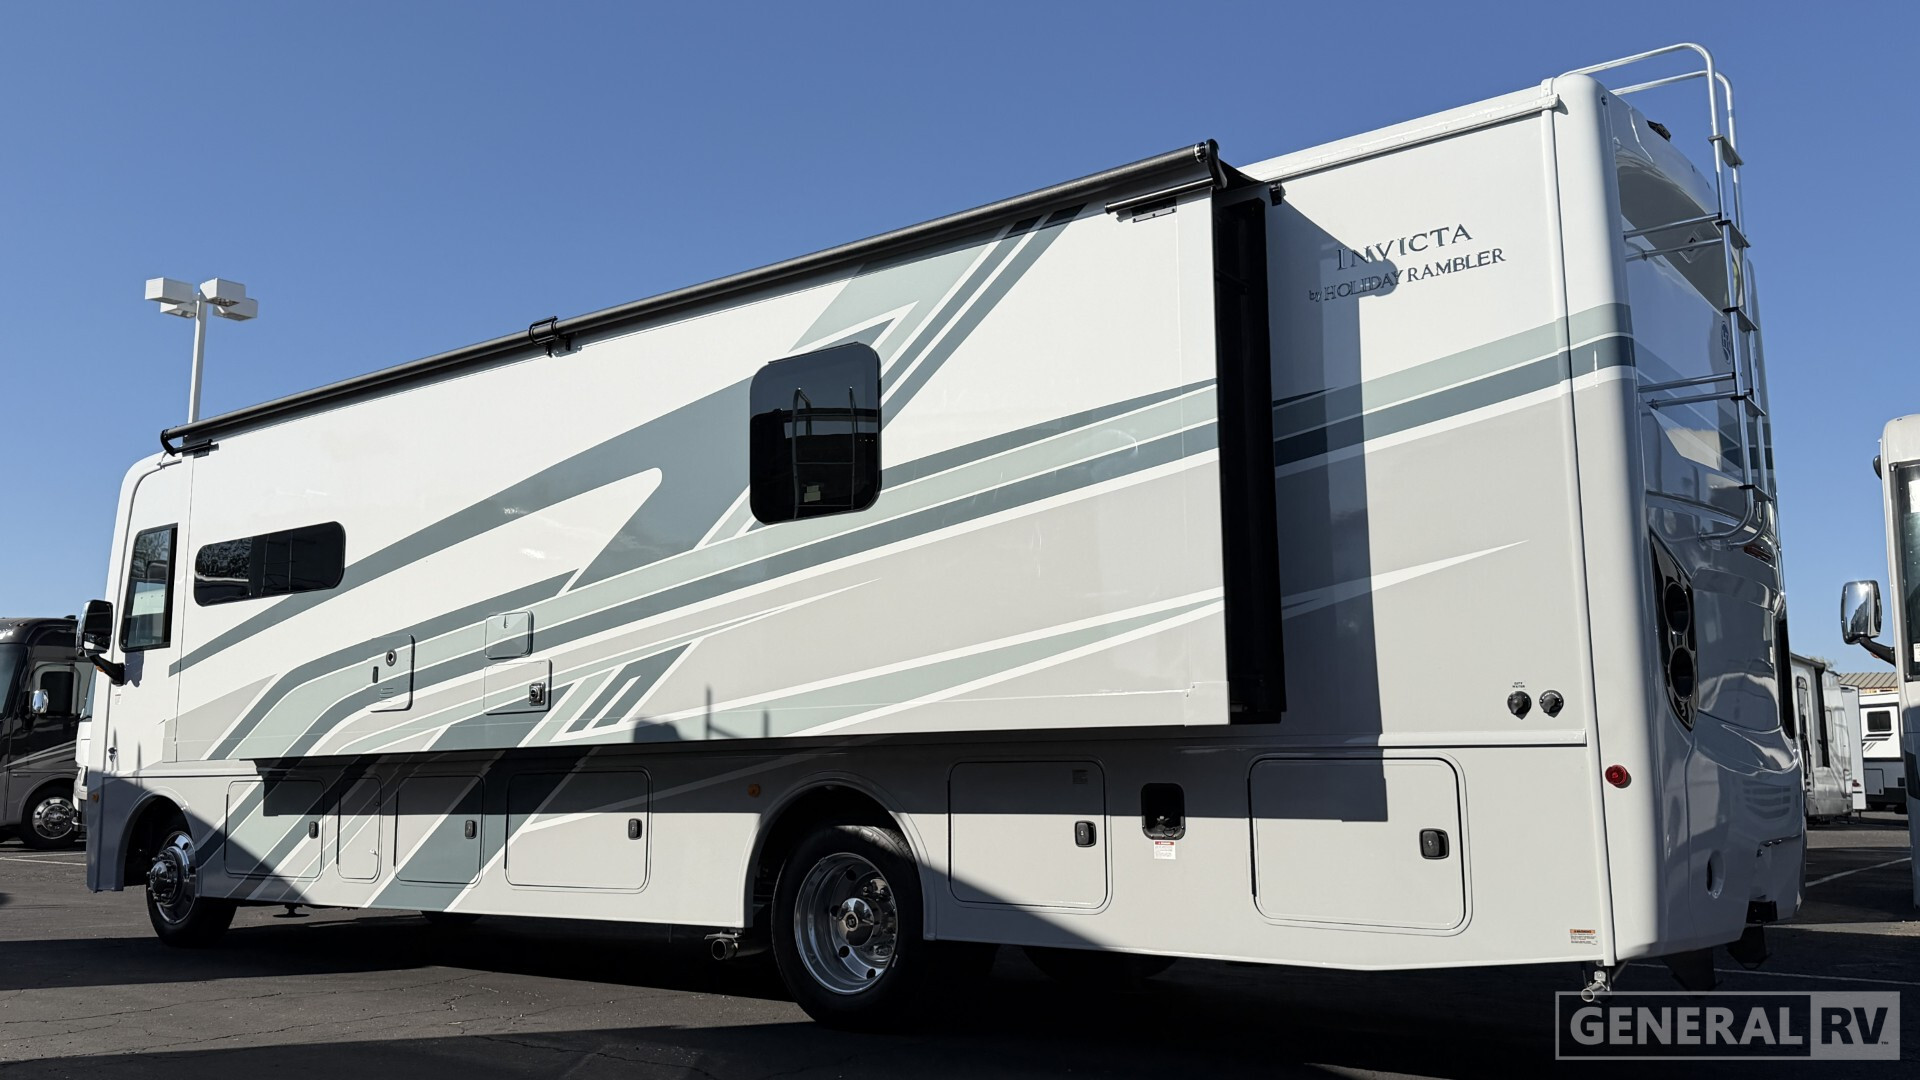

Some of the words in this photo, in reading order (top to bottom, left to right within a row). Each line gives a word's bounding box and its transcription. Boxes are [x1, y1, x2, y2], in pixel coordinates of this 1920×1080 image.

[1336, 223, 1473, 271] INVICTA
[1309, 289, 1322, 302] by
[1323, 269, 1403, 301] HOLIDAY
[1406, 248, 1506, 283] RAMBLER
